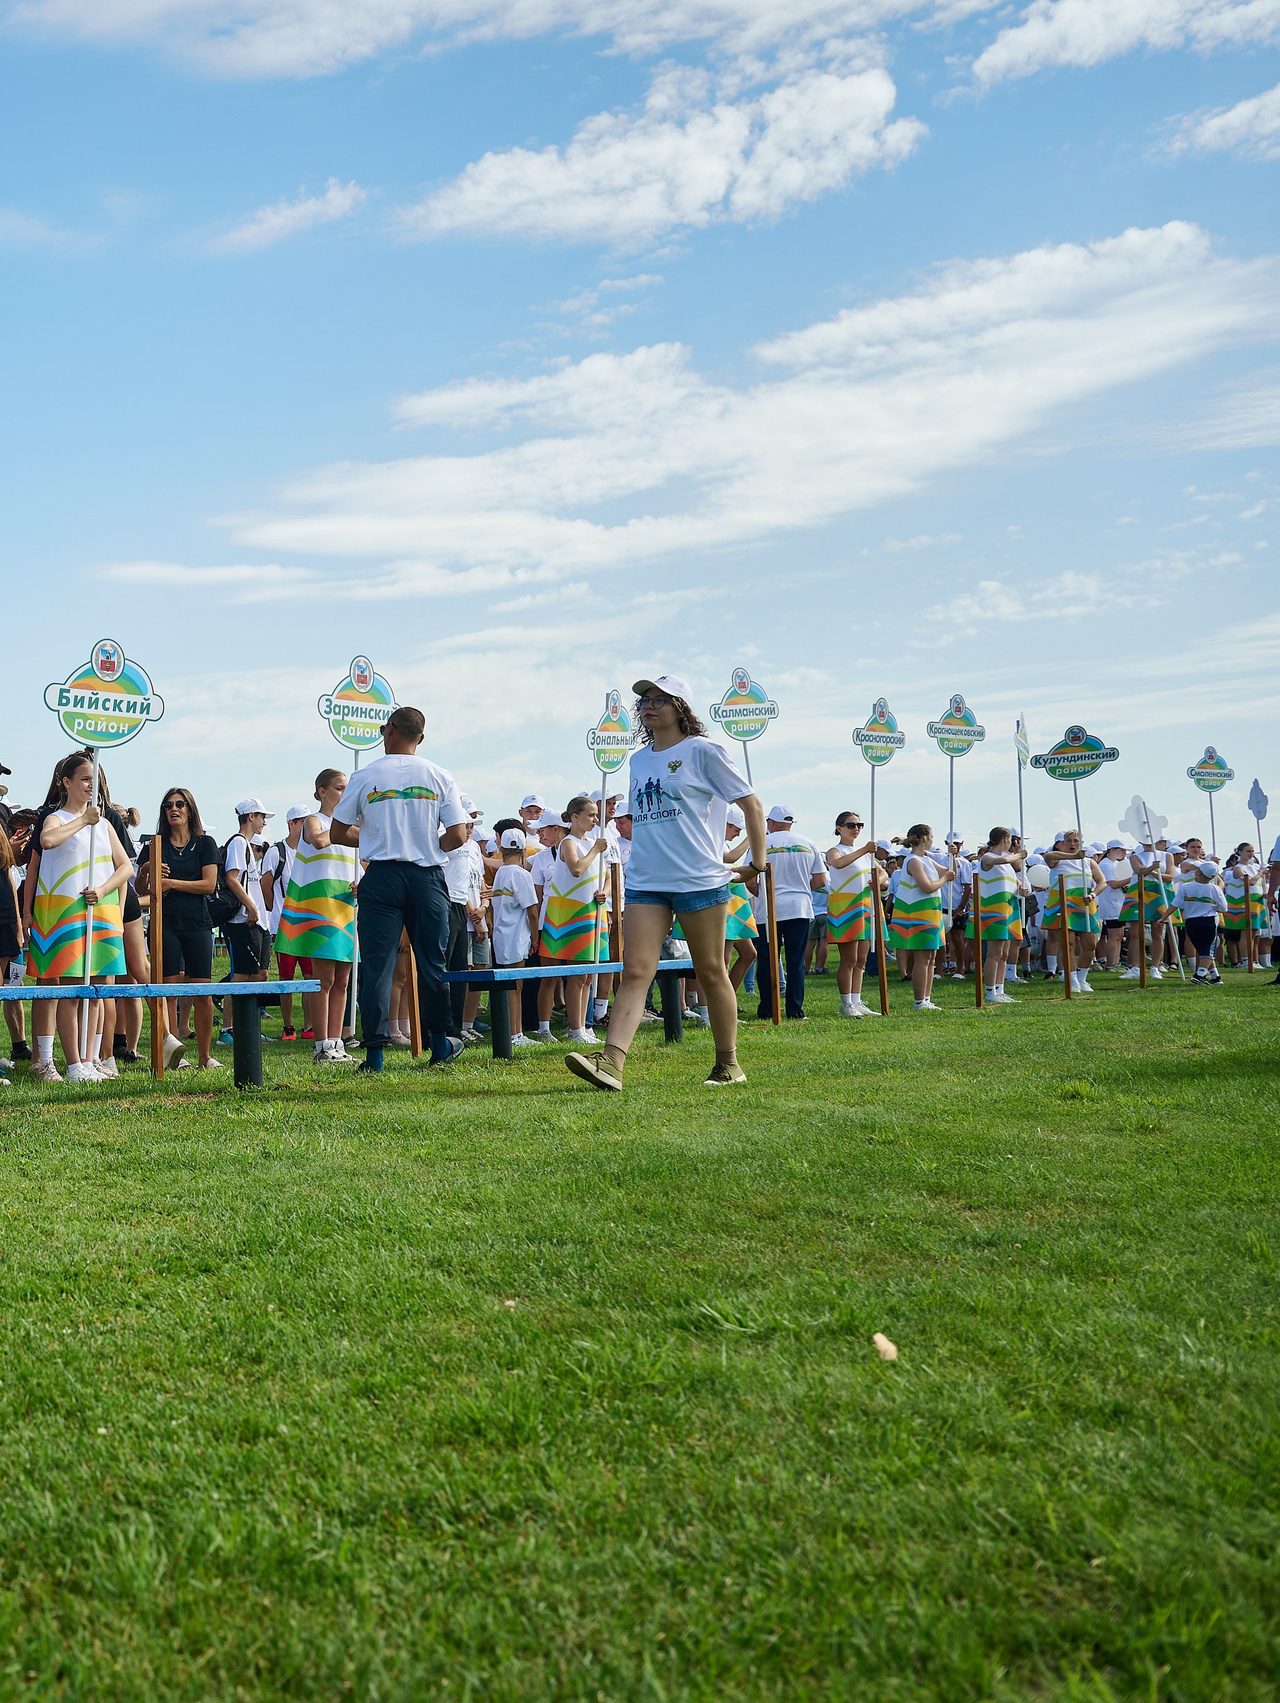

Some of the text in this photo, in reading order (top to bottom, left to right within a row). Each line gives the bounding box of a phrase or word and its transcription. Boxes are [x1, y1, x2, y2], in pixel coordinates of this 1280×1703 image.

[57, 687, 151, 715] Бийский
[713, 703, 776, 719] Калманский
[73, 716, 129, 734] район
[340, 723, 379, 739] район
[731, 720, 761, 735] район
[929, 723, 985, 738] Краснощековский
[943, 739, 968, 750] район
[600, 750, 623, 764] район
[867, 747, 890, 758] район
[1034, 749, 1116, 766] Кулундинский
[1055, 765, 1092, 777] район
[1190, 768, 1232, 779] Смоленский
[650, 808, 683, 820] СПОРТА
